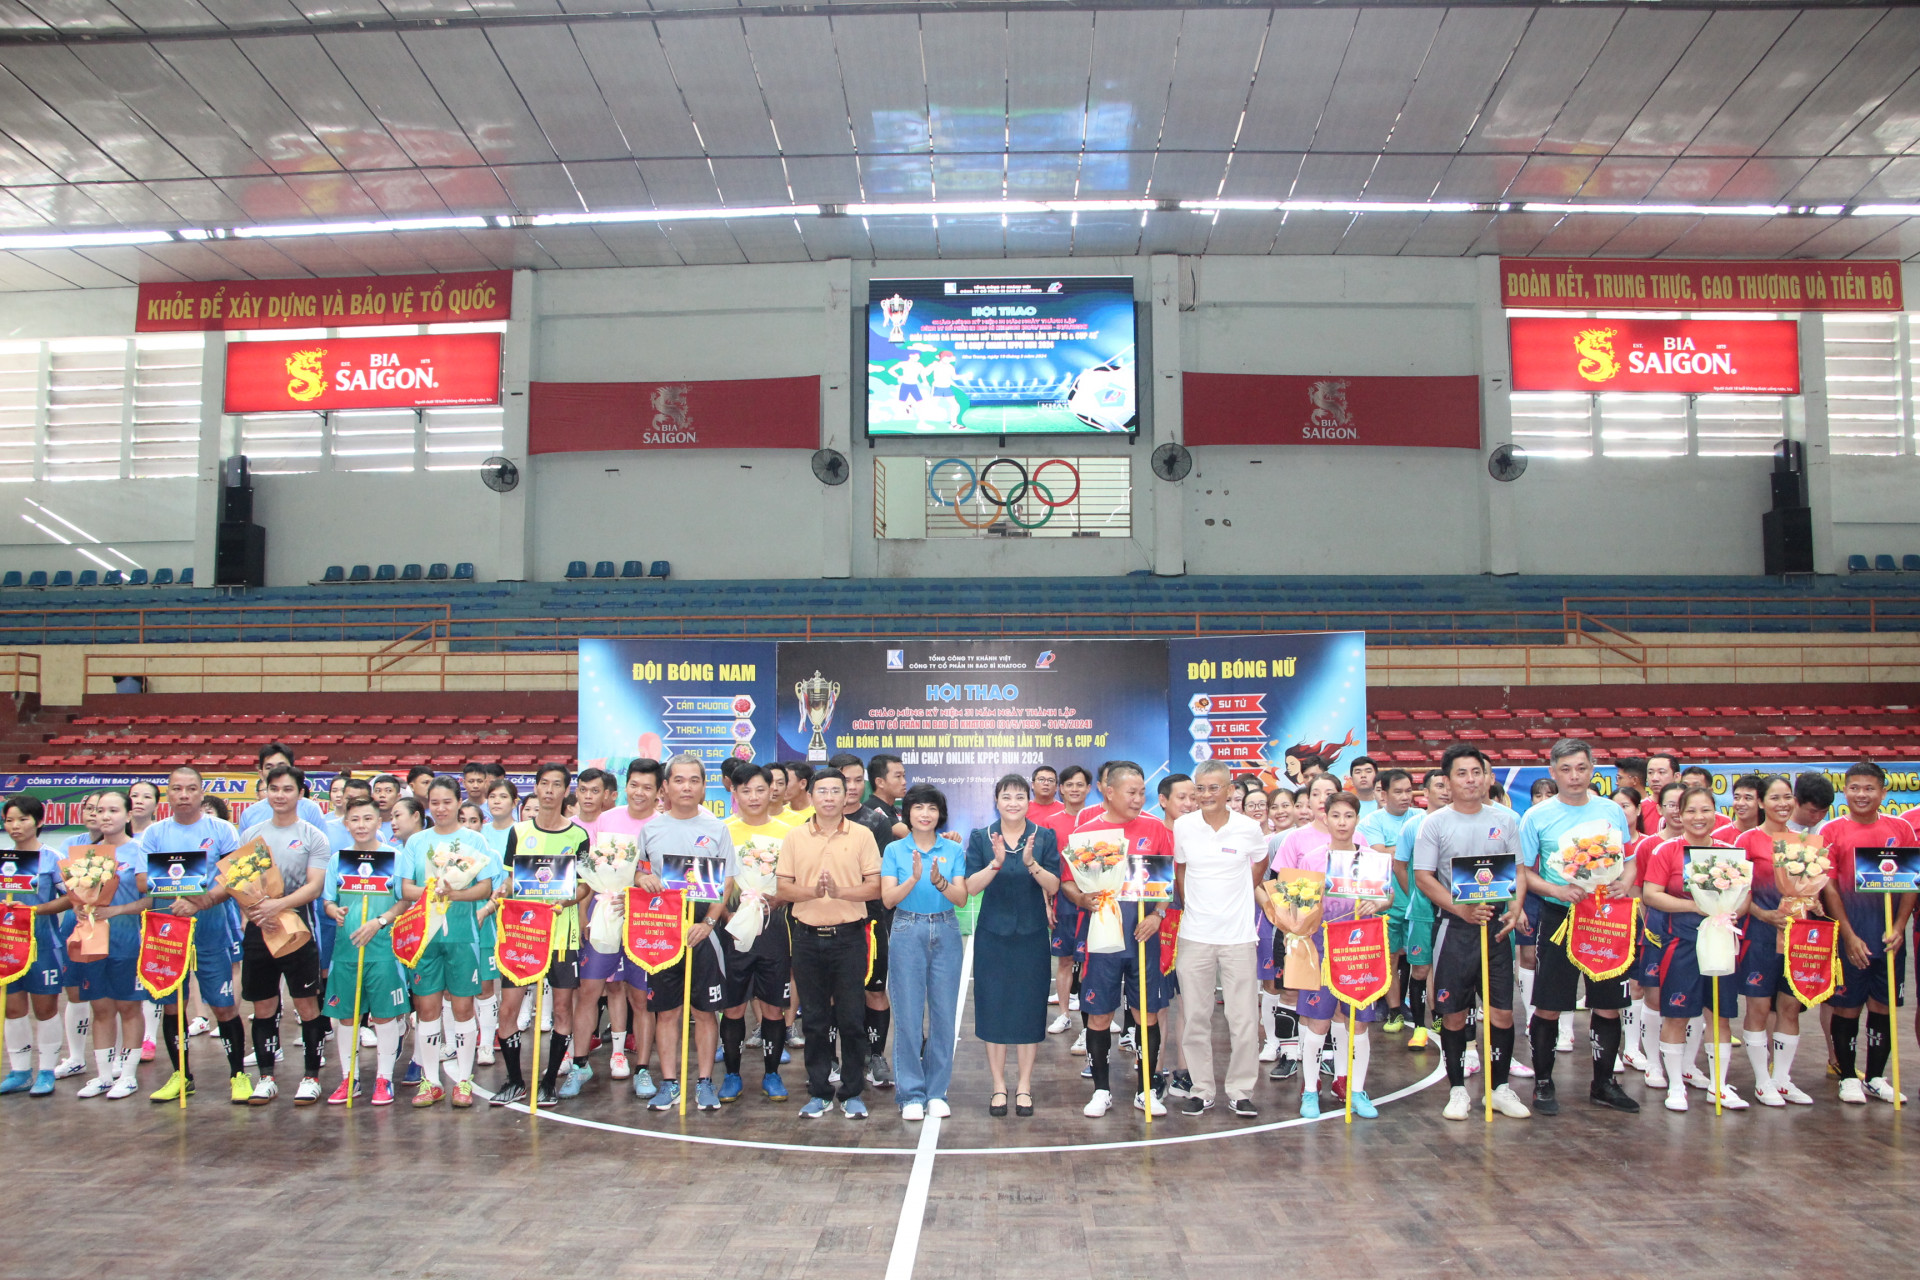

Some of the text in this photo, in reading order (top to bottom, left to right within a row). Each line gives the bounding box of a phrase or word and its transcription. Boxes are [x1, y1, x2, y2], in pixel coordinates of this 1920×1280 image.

[1507, 264, 1894, 305] ĐOÀN KẾT, TRUNG THỰC, CAO THƯỢNG VÀ TIẾN BỘ
[147, 279, 496, 322] KHỎE ĐỂ XÂY DỰNG VÀ BẢO VỆ TỔ QUỐC
[972, 306, 1037, 318] HỘI THAO
[1663, 337, 1696, 351] BIA
[370, 353, 400, 367] BIA
[1321, 419, 1338, 427] BIA
[643, 431, 696, 444] SAIGON
[1302, 427, 1357, 440] SAIGON
[929, 654, 945, 662] TỔNG
[947, 654, 966, 662] CÔNG
[999, 654, 1011, 662] VIỆT
[938, 661, 948, 669] CỔ
[632, 660, 756, 684] ĐỘI BÓNG NAM
[1187, 656, 1297, 683] ĐỘI BÓNG NỮ
[926, 682, 1019, 703] HỘI THAO
[852, 718, 874, 730] CÔNG
[875, 720, 886, 730] TY
[886, 717, 899, 730] CỔ
[900, 717, 921, 729] PHẦN
[922, 720, 931, 729] IN
[932, 720, 948, 729] BAO
[949, 719, 959, 729] BÌ
[960, 720, 996, 729] KHATOCO
[836, 732, 854, 748] GIẢI
[856, 733, 880, 748] BÓNG
[881, 733, 894, 748] ĐÁ
[895, 735, 915, 748] MINI
[917, 735, 937, 748] NAM
[938, 733, 952, 748] NỮ
[952, 731, 985, 748] TRUYỀN
[986, 731, 1015, 748] THỐNG
[1017, 731, 1033, 747] LẦN
[1035, 732, 1053, 747] THỨ
[1053, 735, 1064, 747] 15
[1074, 735, 1092, 747] CUP
[901, 749, 1044, 767] GIẢI CHẠY ONLINE KPPC RUN 2024
[27, 777, 51, 785] CÔNG
[64, 776, 78, 785] CỔ
[78, 776, 101, 785] PHẦN
[42, 969, 58, 985] 12
[472, 969, 479, 985] 4
[391, 988, 404, 1006] 10
